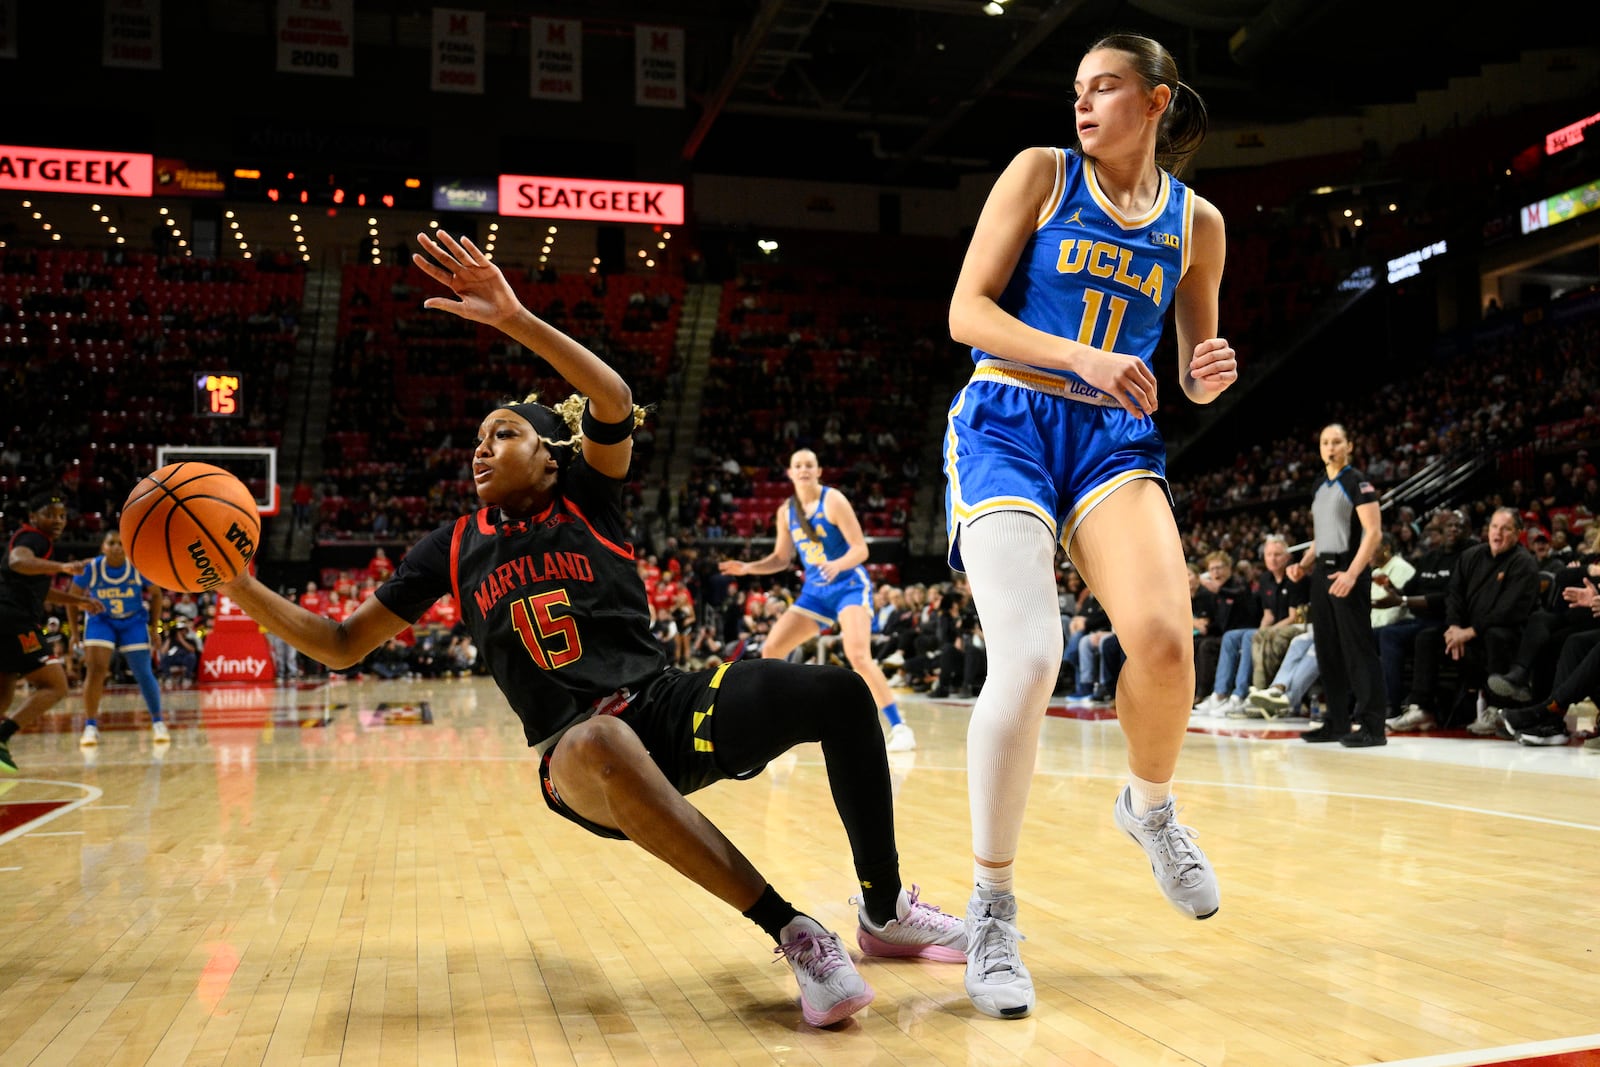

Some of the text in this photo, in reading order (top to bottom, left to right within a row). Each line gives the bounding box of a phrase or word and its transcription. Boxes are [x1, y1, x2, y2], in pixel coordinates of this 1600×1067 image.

[291, 50, 340, 68] 2006
[0, 156, 131, 188] ATGEEK
[517, 183, 664, 216] SEATGEEK
[1056, 239, 1164, 307] UCLA
[1076, 287, 1129, 353] 11
[211, 389, 236, 414] 15
[96, 586, 135, 599] UCLA
[474, 551, 595, 621] MARYLAND
[109, 598, 125, 615] 3
[510, 588, 583, 670] 15
[204, 654, 267, 679] xfinity
